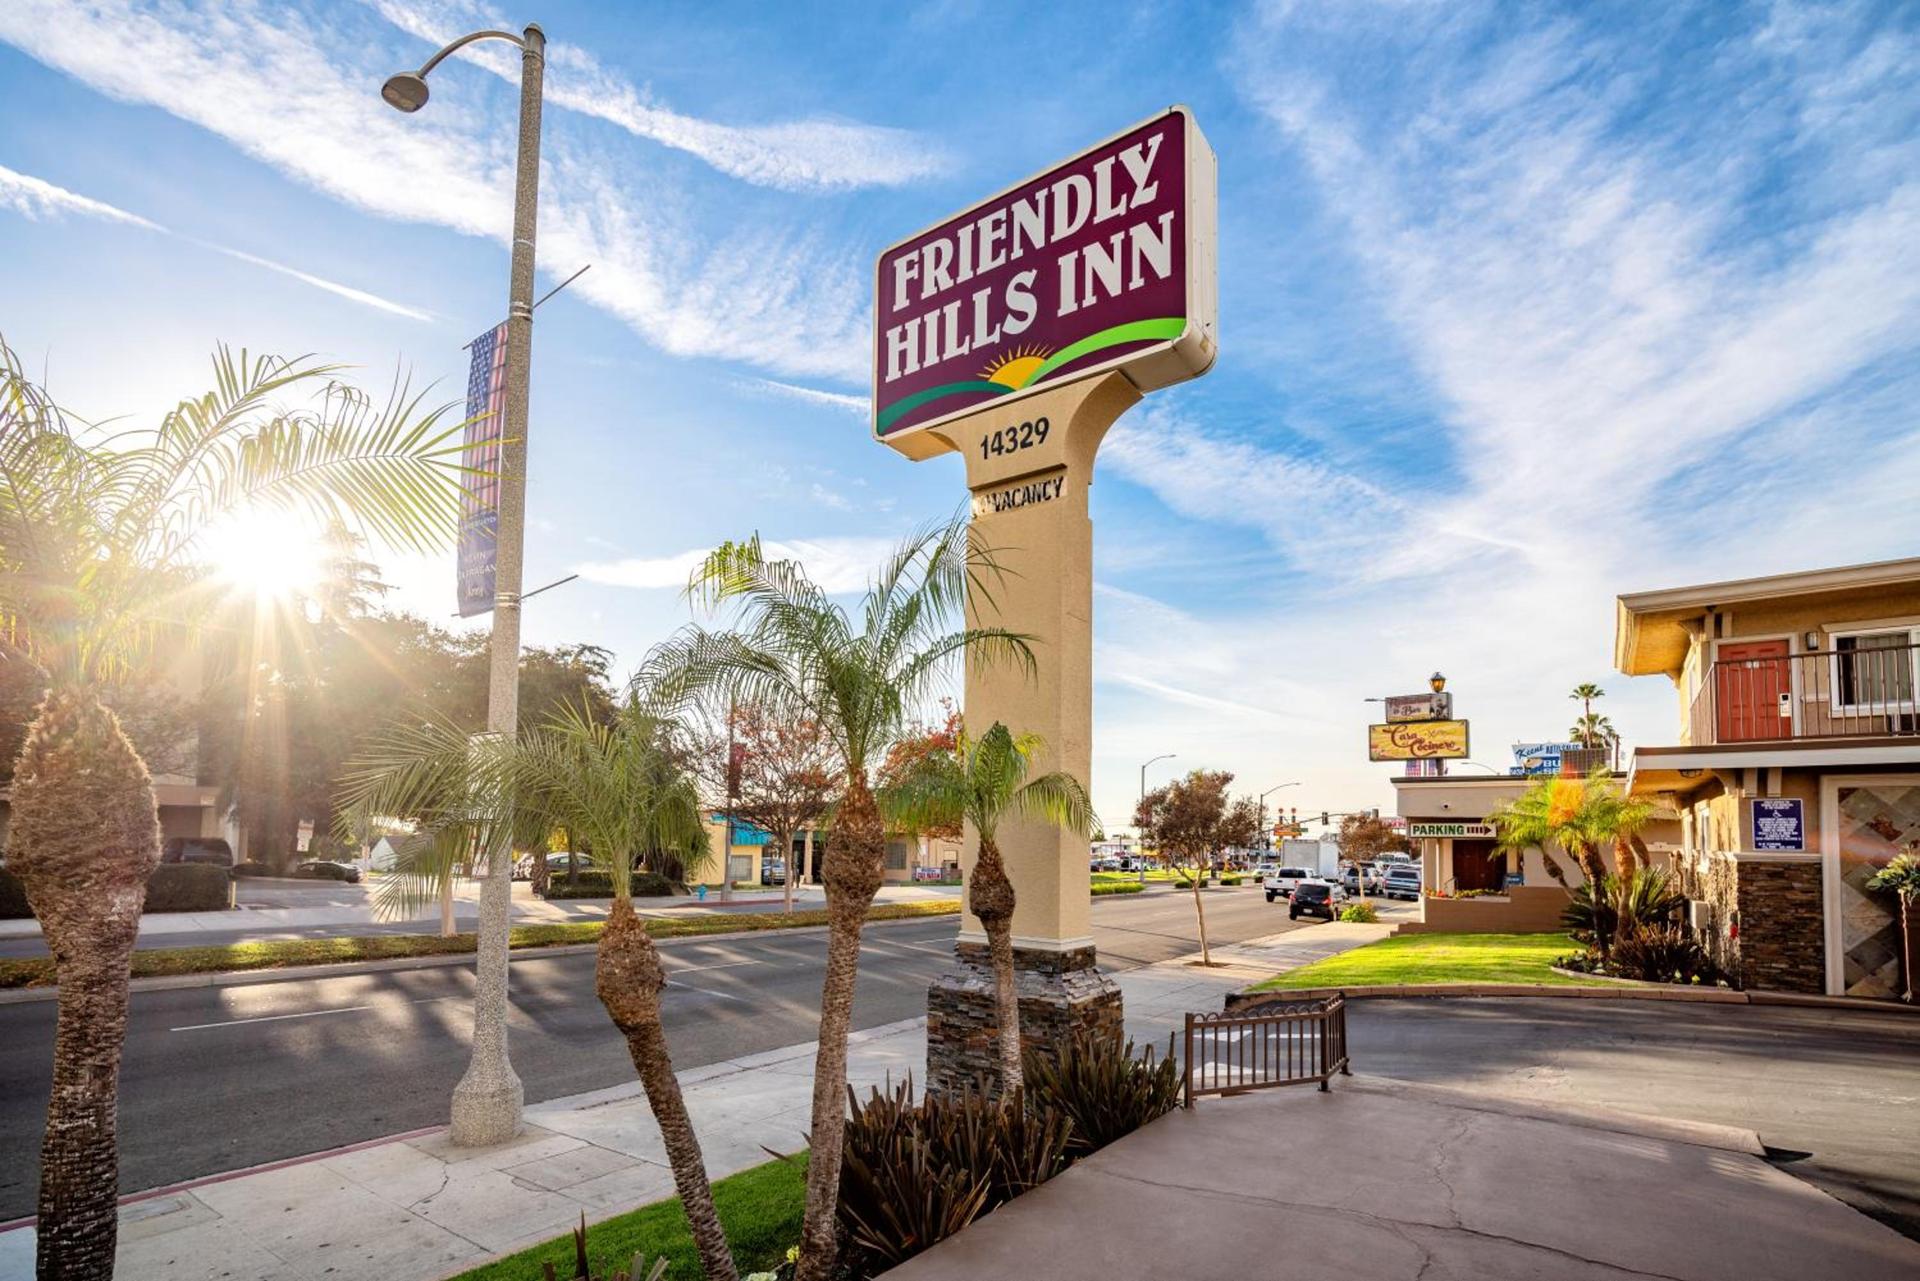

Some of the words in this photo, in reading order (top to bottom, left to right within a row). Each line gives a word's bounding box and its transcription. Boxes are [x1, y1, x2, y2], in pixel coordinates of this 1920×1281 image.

[892, 132, 1164, 312] FRIENDLY
[885, 268, 1038, 383] HILLS
[1056, 210, 1175, 318] INN
[980, 416, 1050, 460] 14329
[991, 475, 1064, 512] VACANCY
[1383, 725, 1418, 748] Casa
[1410, 740, 1461, 758] Cocinero
[1412, 825, 1465, 835] PARKING
